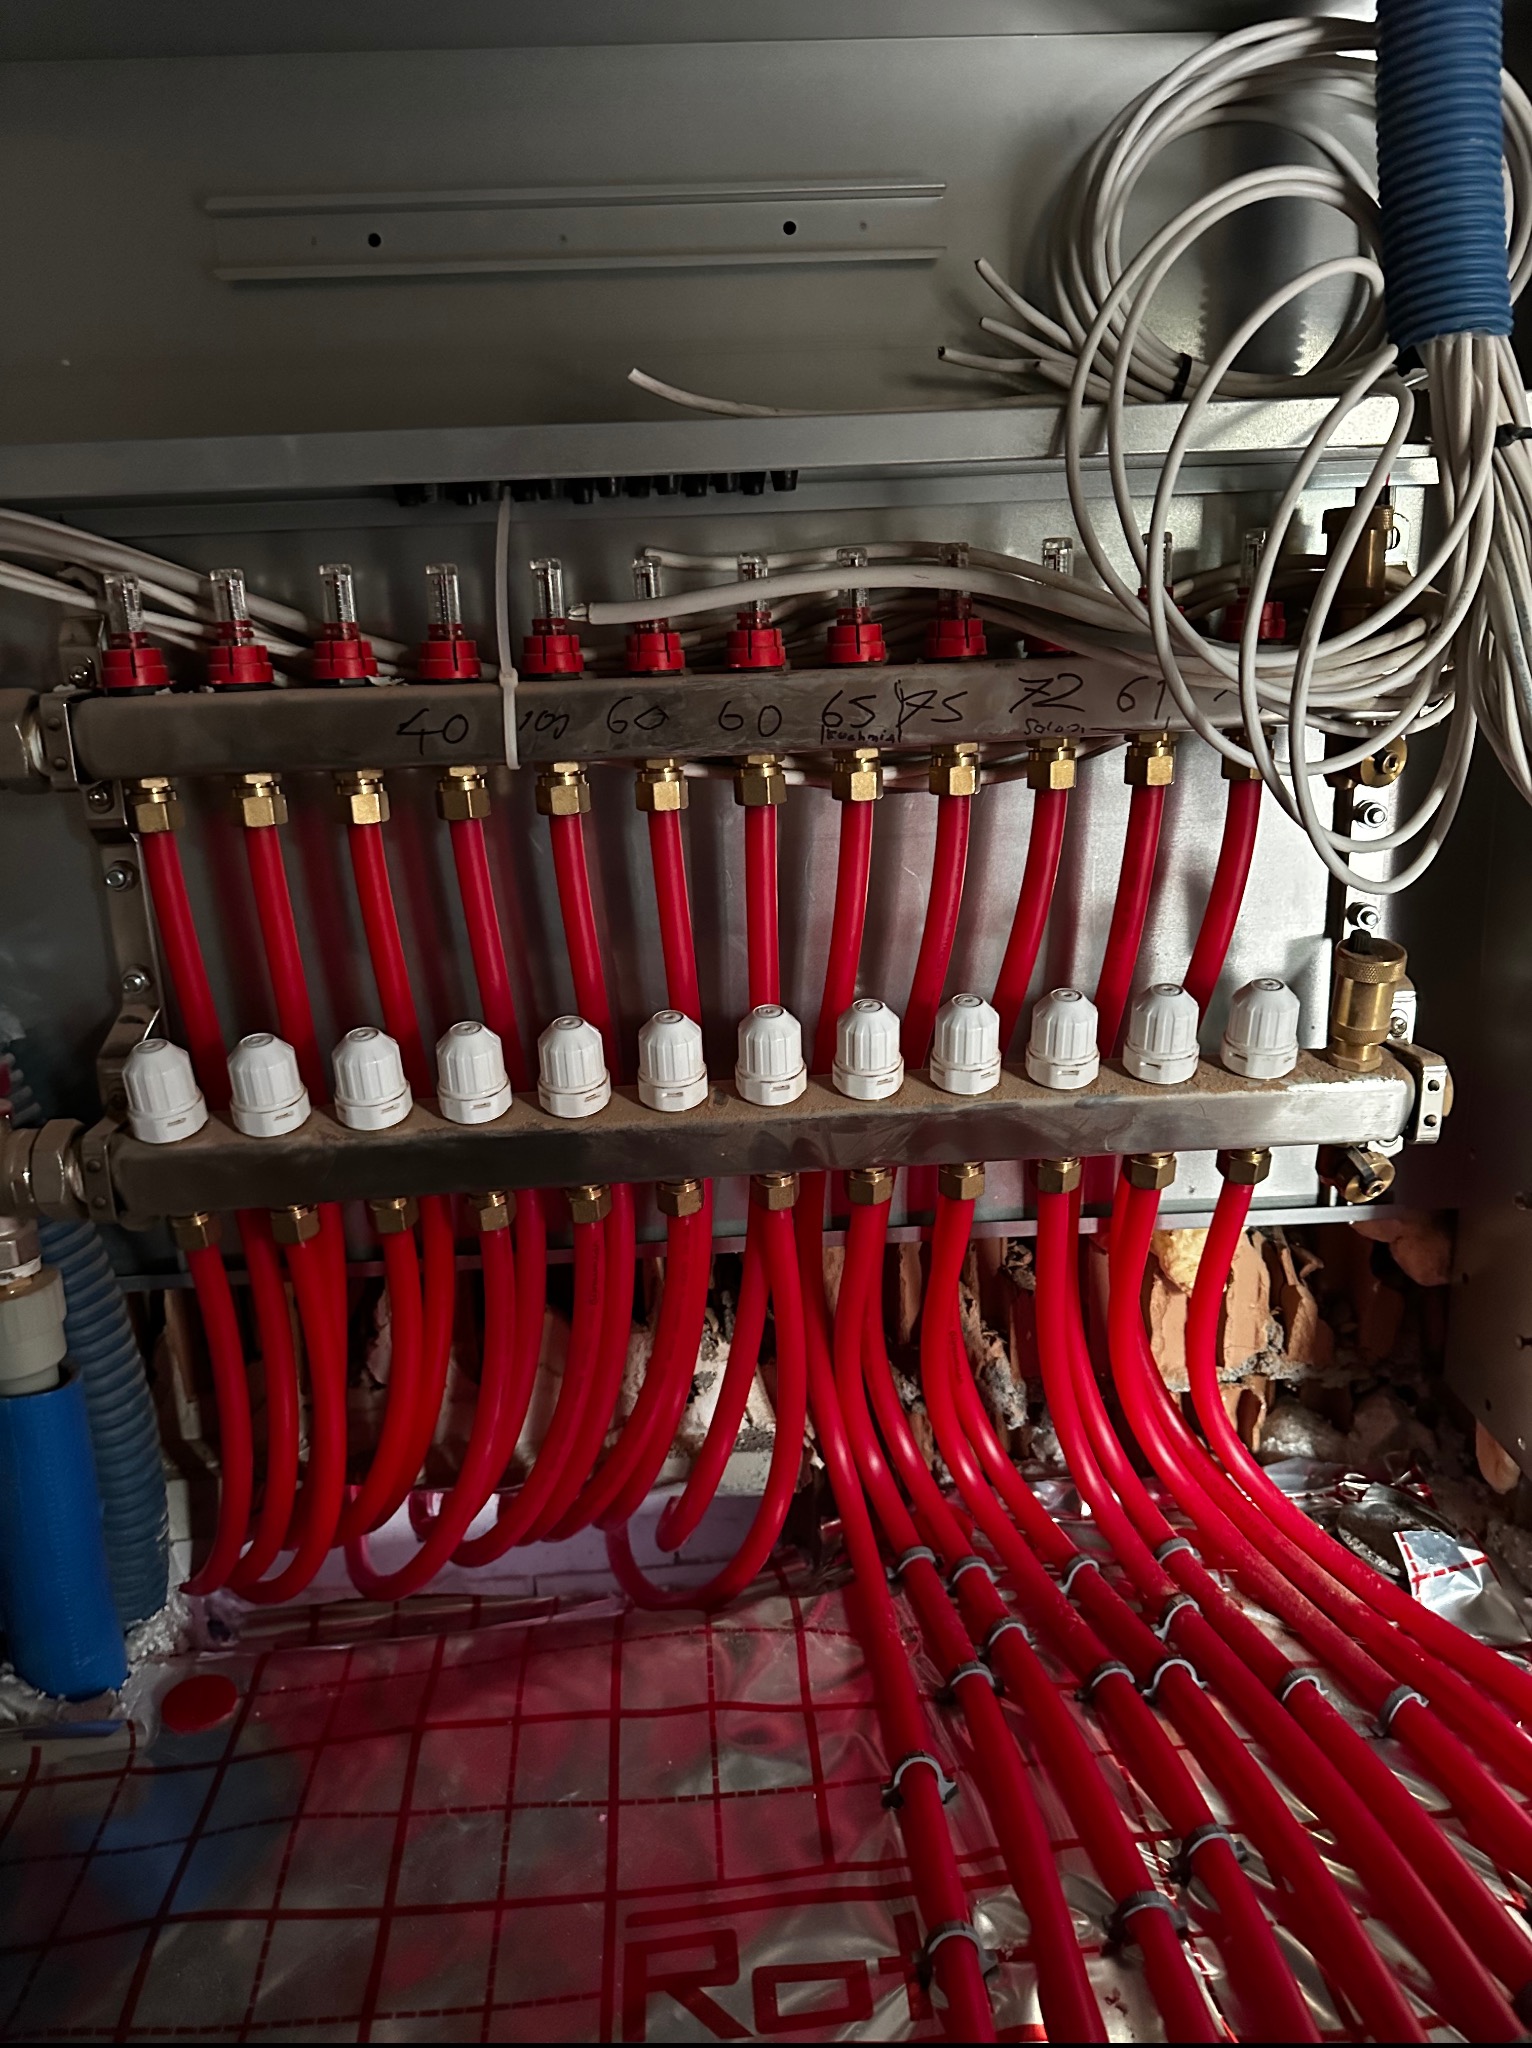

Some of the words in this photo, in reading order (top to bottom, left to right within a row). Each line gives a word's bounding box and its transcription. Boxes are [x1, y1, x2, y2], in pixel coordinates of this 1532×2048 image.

[397, 708, 469, 754] 40
[607, 696, 670, 734] 60
[718, 700, 782, 737] 60
[821, 689, 877, 728] 65
[1009, 673, 1086, 713] 72
[1117, 675, 1168, 720] 61
[622, 1910, 936, 2043] Rot
